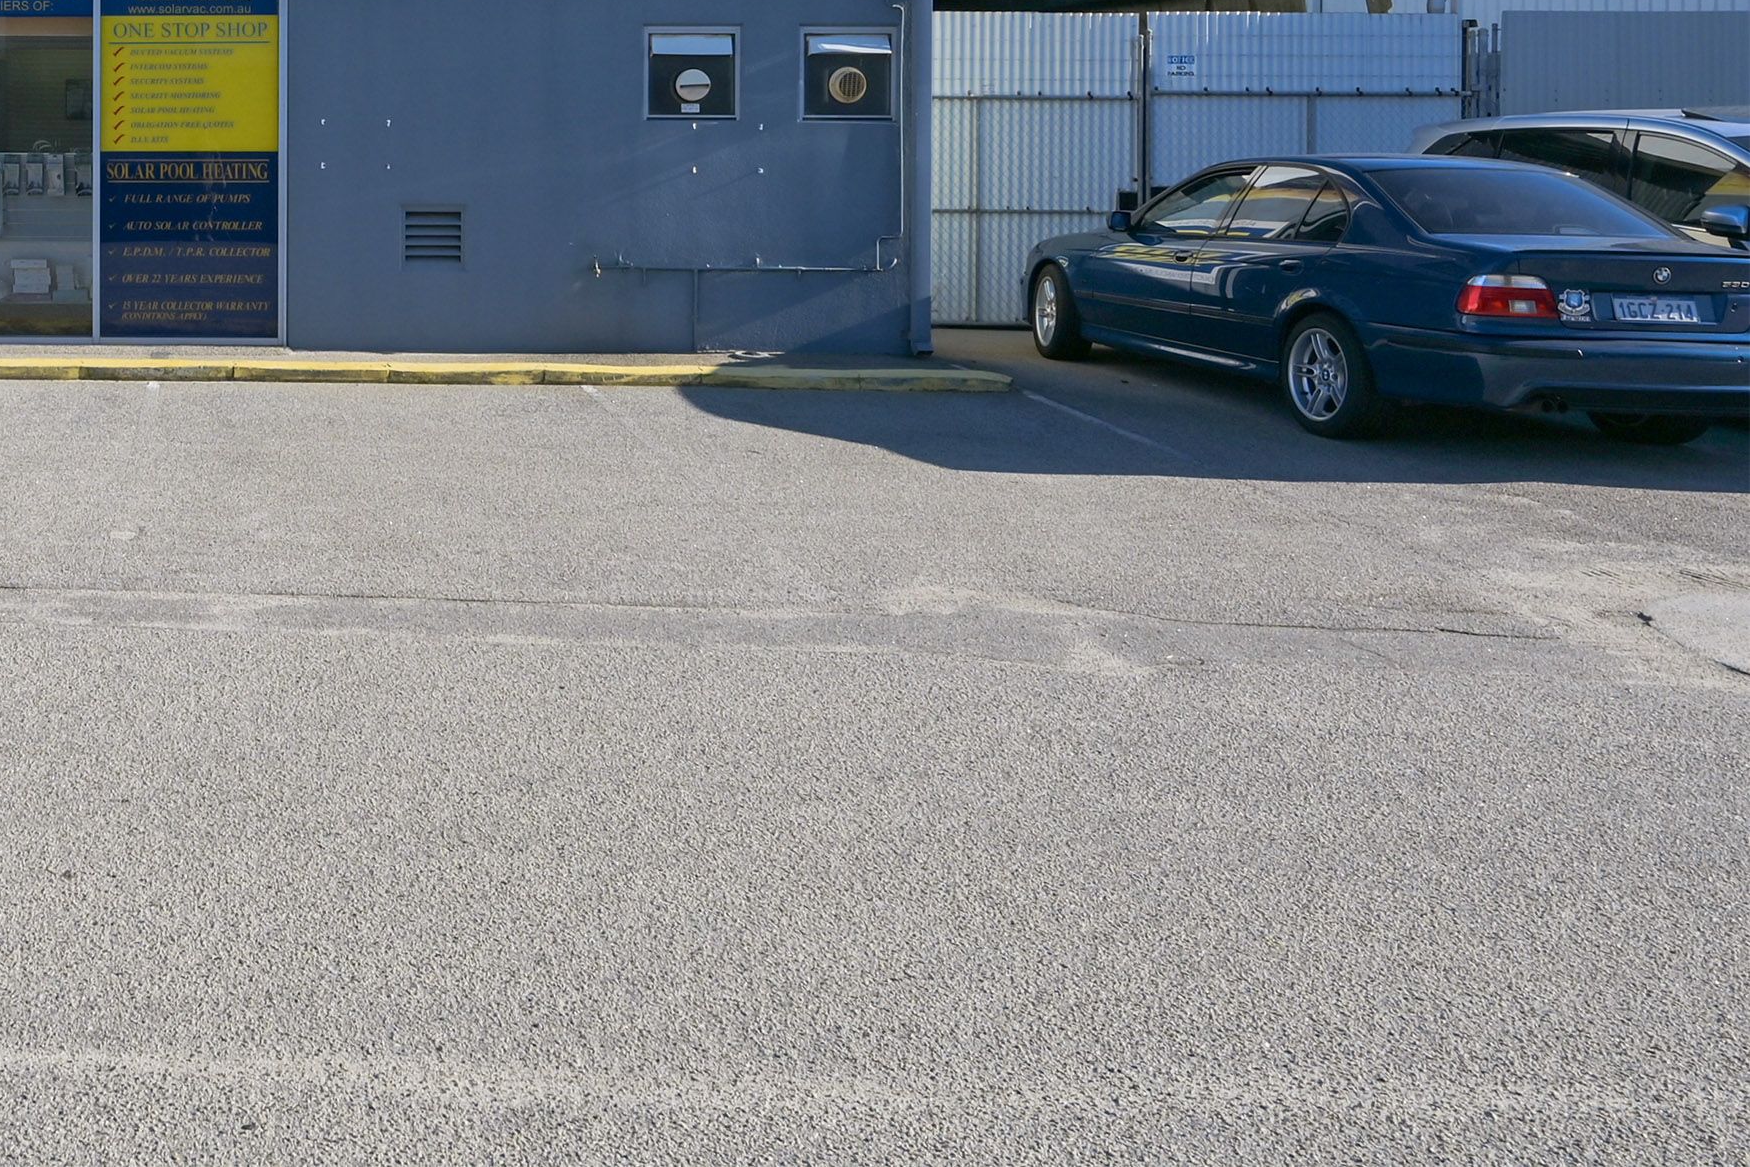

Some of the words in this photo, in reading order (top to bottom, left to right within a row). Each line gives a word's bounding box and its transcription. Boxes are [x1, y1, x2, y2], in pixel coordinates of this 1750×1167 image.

[33, 0, 54, 11] OF:
[128, 4, 251, 14] www.solarvac.com.au
[113, 22, 154, 39] ONE
[161, 22, 210, 38] STOP
[216, 21, 268, 38] SHOP
[107, 162, 155, 180] SOLAR
[160, 162, 198, 180] POOL
[203, 162, 268, 179] HEATING
[124, 194, 152, 203] FULL
[155, 194, 193, 203] RANGE
[196, 194, 212, 203] OF
[213, 194, 251, 203] PUMPS
[124, 221, 152, 230] AUTO
[154, 221, 189, 230] SOLAR
[192, 221, 263, 230] CONTROLLER
[209, 247, 271, 257] COLLECTOR
[122, 274, 148, 283] OVER
[165, 274, 197, 283] YEARS
[200, 274, 264, 283] EXPERIENCE
[134, 301, 159, 310] YEAR
[161, 301, 214, 310] COLLECTOR
[216, 301, 270, 310] WARRANTY
